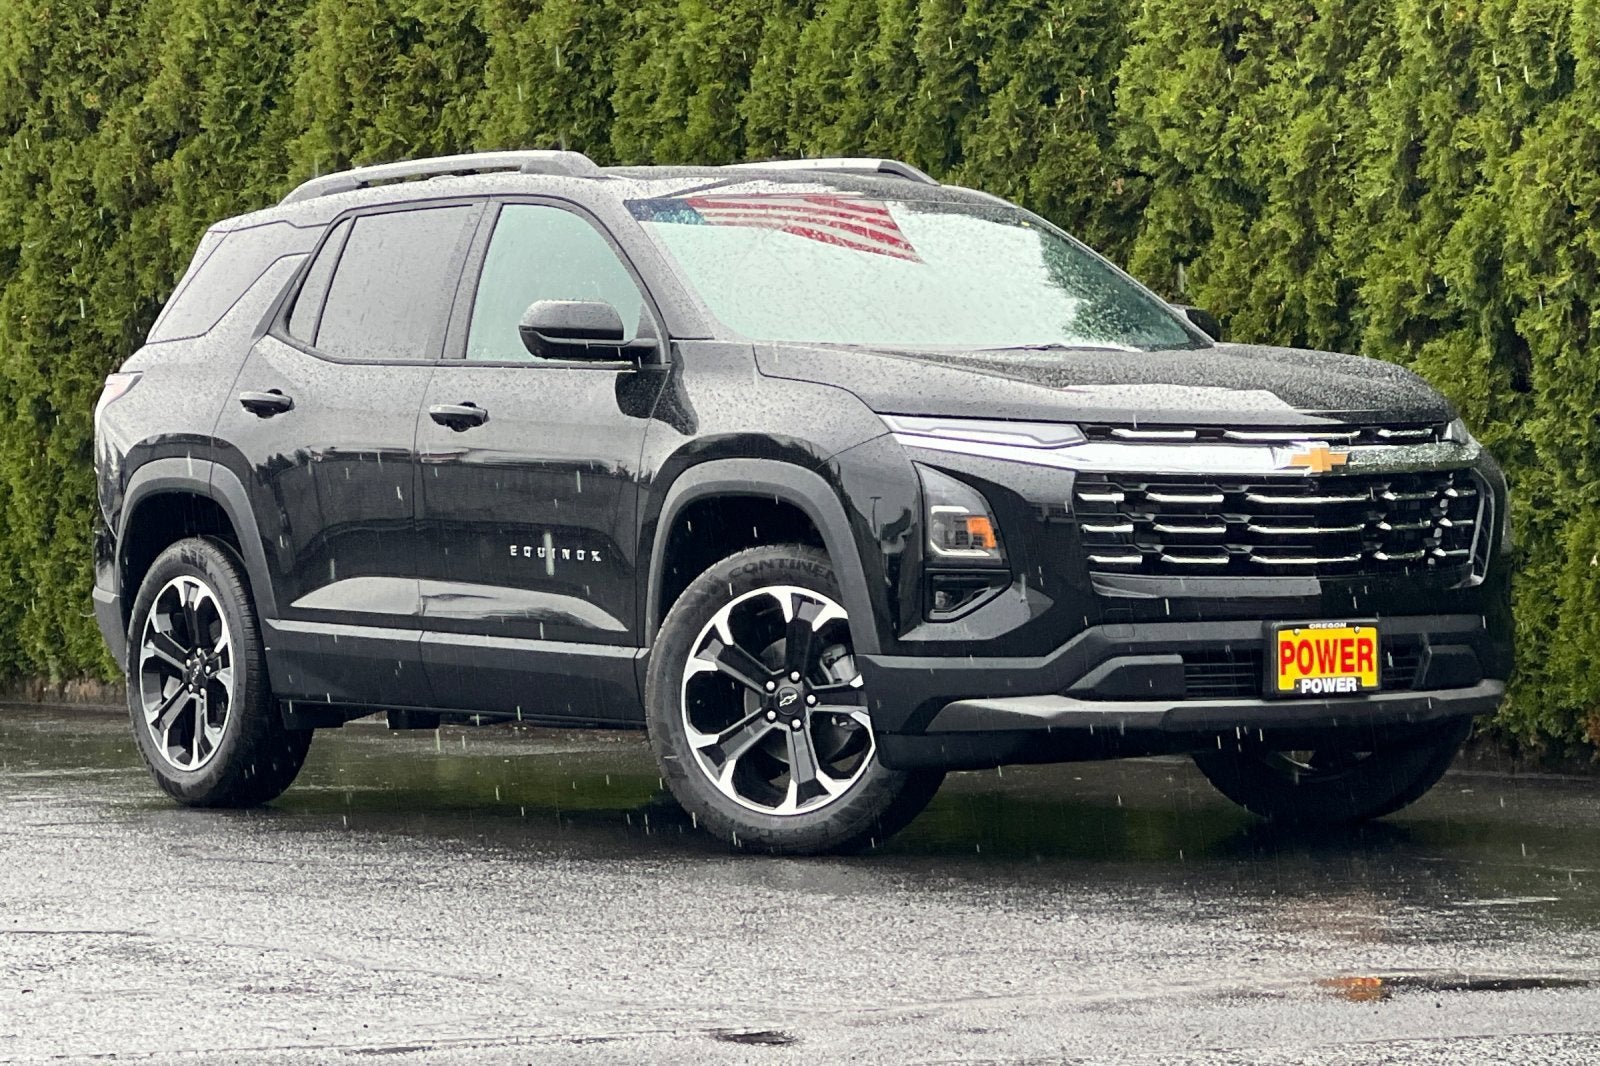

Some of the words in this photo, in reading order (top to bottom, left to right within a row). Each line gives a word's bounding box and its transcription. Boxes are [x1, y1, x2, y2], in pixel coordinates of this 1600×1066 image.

[509, 545, 602, 562] EQUINOX
[1279, 638, 1374, 675] POWER
[1301, 677, 1357, 694] POWER
